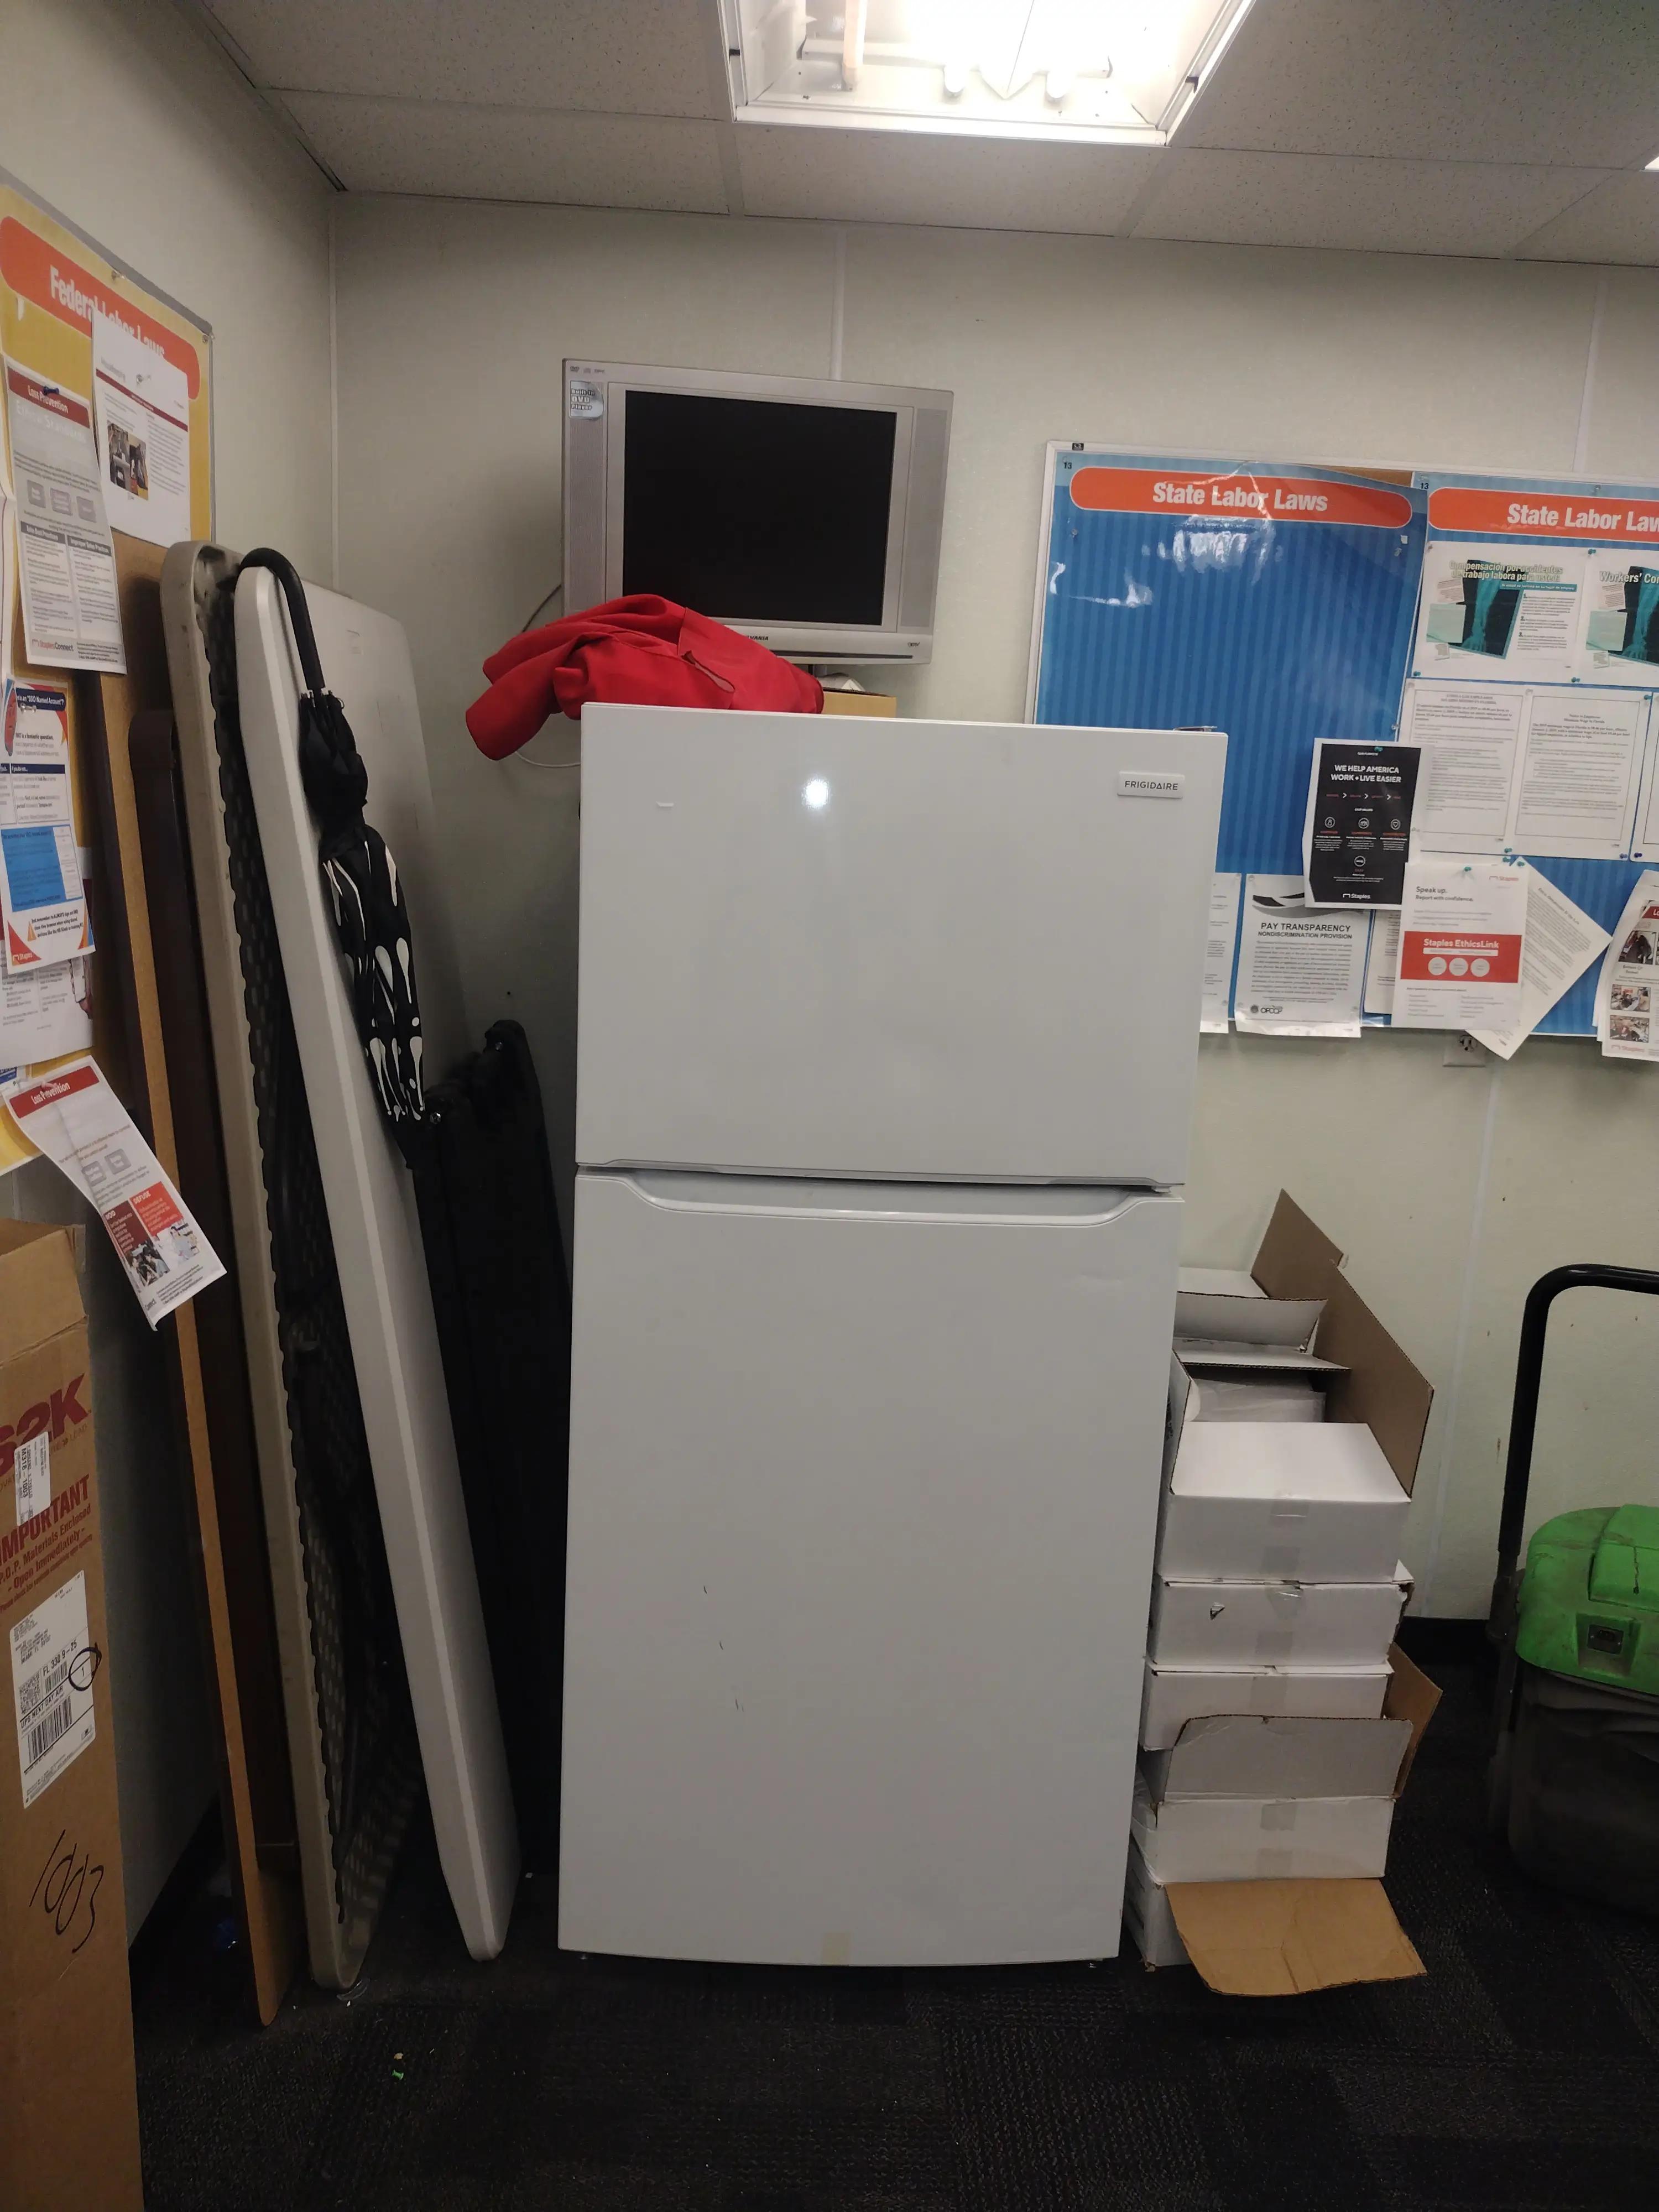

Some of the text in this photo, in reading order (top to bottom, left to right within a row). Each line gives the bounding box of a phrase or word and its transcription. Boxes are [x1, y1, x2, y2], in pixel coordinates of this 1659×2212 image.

[28, 385, 69, 414] Loss Prevention
[1153, 482, 1328, 512] State Labor Laws
[1507, 503, 1559, 526] State
[1564, 508, 1621, 530] Labor
[1463, 571, 1490, 580] trabajo
[1491, 571, 1515, 580] labora
[1506, 565, 1521, 573] por
[54, 643, 74, 652] Connect
[1124, 780, 1179, 790] FRIGIDAIRE
[1281, 923, 1351, 932] TRANSPARENCY
[1423, 938, 1499, 948] Staples EthicsLink
[30, 1082, 71, 1105] Loss Prevention
[23, 1530, 58, 1566] Materials
[60, 1503, 91, 1536] Enclosed
[14, 1567, 33, 1589] Open
[36, 1530, 80, 1572] Immediately
[43, 1665, 50, 1677] FL
[81, 1666, 85, 1677] 1
[21, 1685, 64, 1729] UPS NEXT DAY AIR
[29, 1828, 105, 1954] 1003
